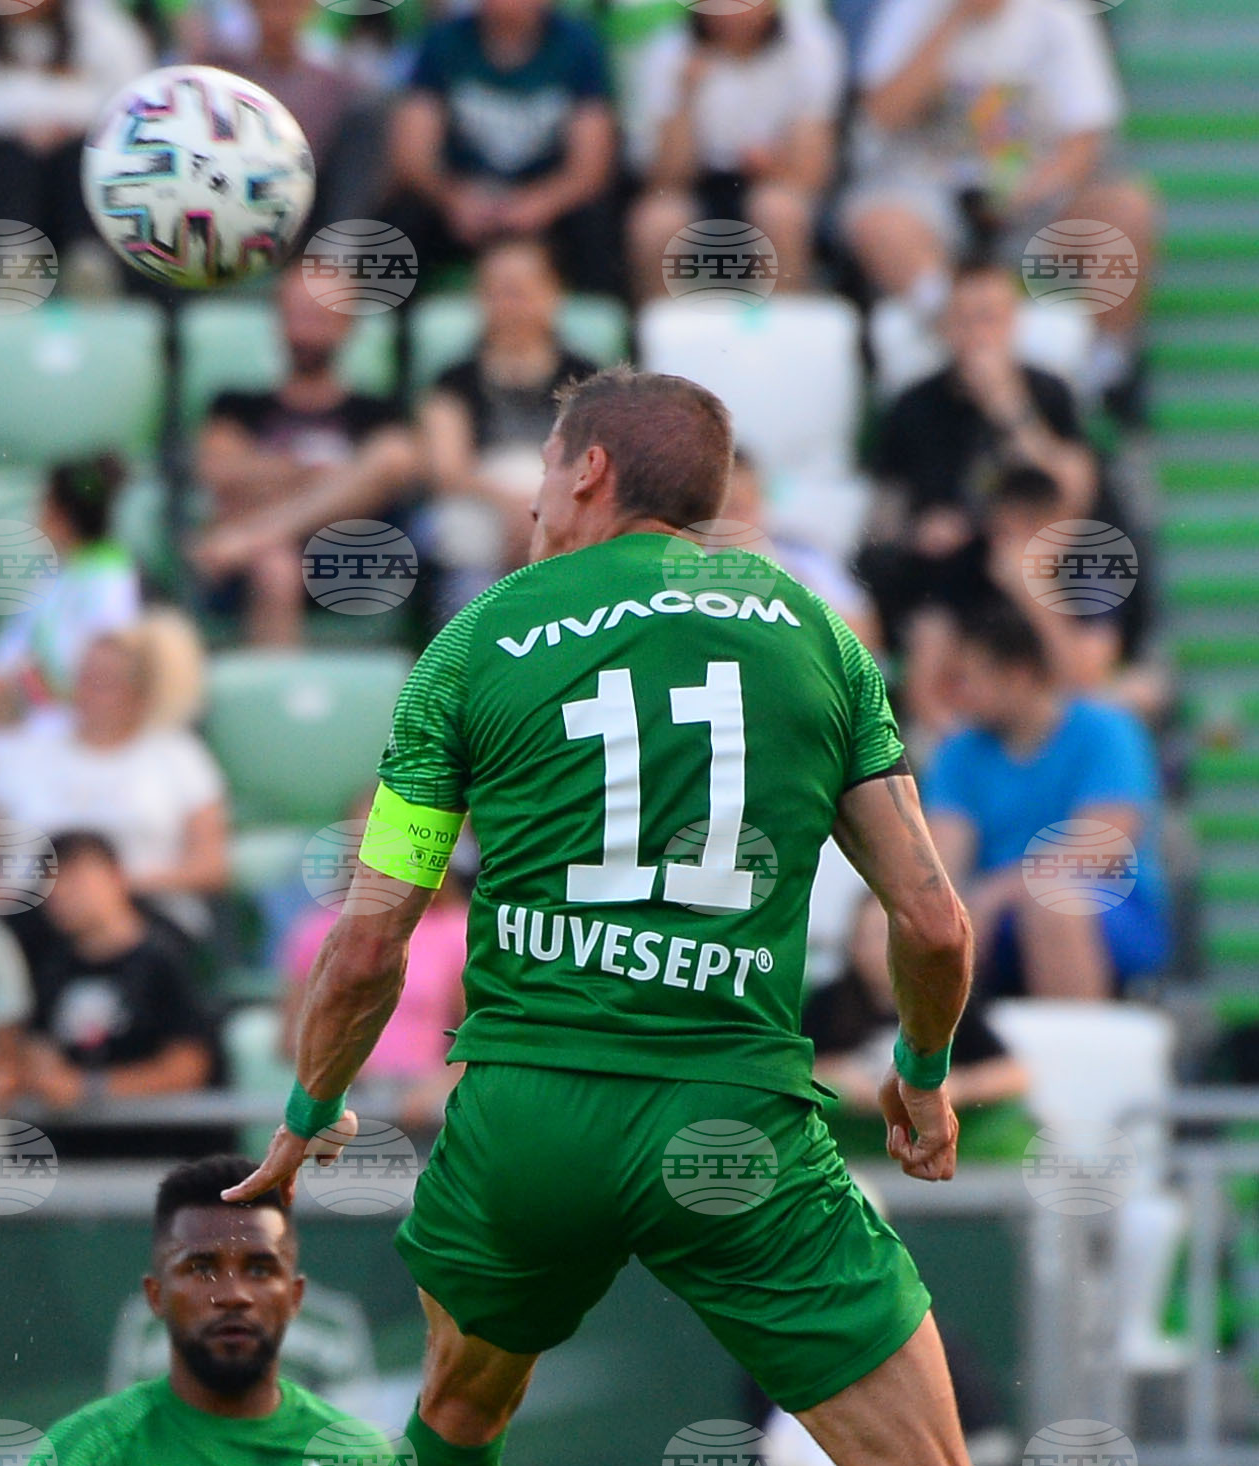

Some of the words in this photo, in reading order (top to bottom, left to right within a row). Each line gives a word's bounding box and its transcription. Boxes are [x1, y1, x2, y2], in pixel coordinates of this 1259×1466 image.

[495, 589, 802, 658] VIVACOM
[561, 660, 754, 911] 11
[407, 823, 432, 840] NO
